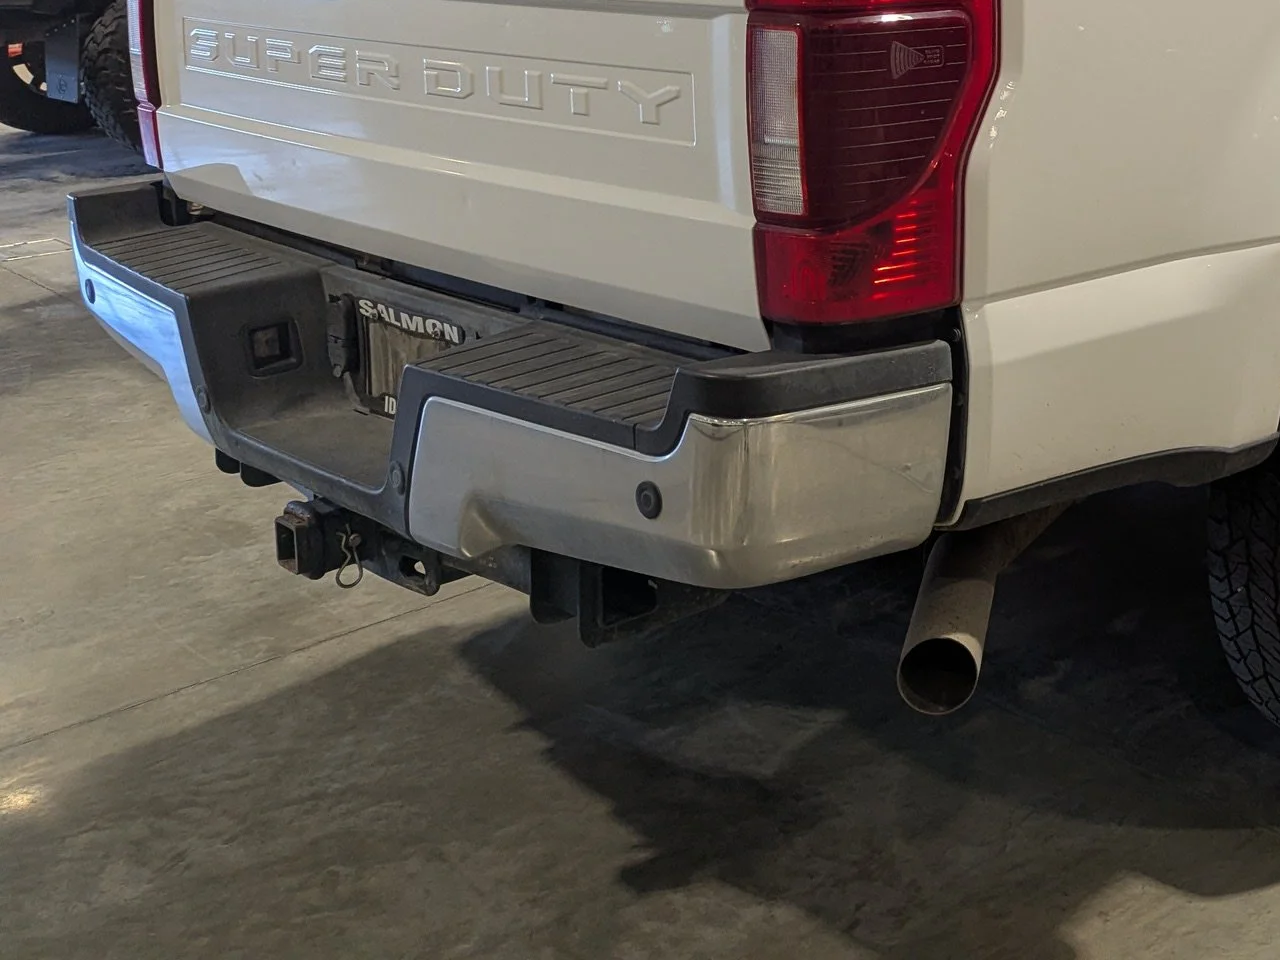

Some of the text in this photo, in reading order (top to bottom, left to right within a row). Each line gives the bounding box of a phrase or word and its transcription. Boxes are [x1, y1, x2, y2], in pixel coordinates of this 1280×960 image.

[188, 27, 682, 126] SUPER DUTY
[358, 299, 459, 344] SALMON
[384, 395, 397, 415] ID
